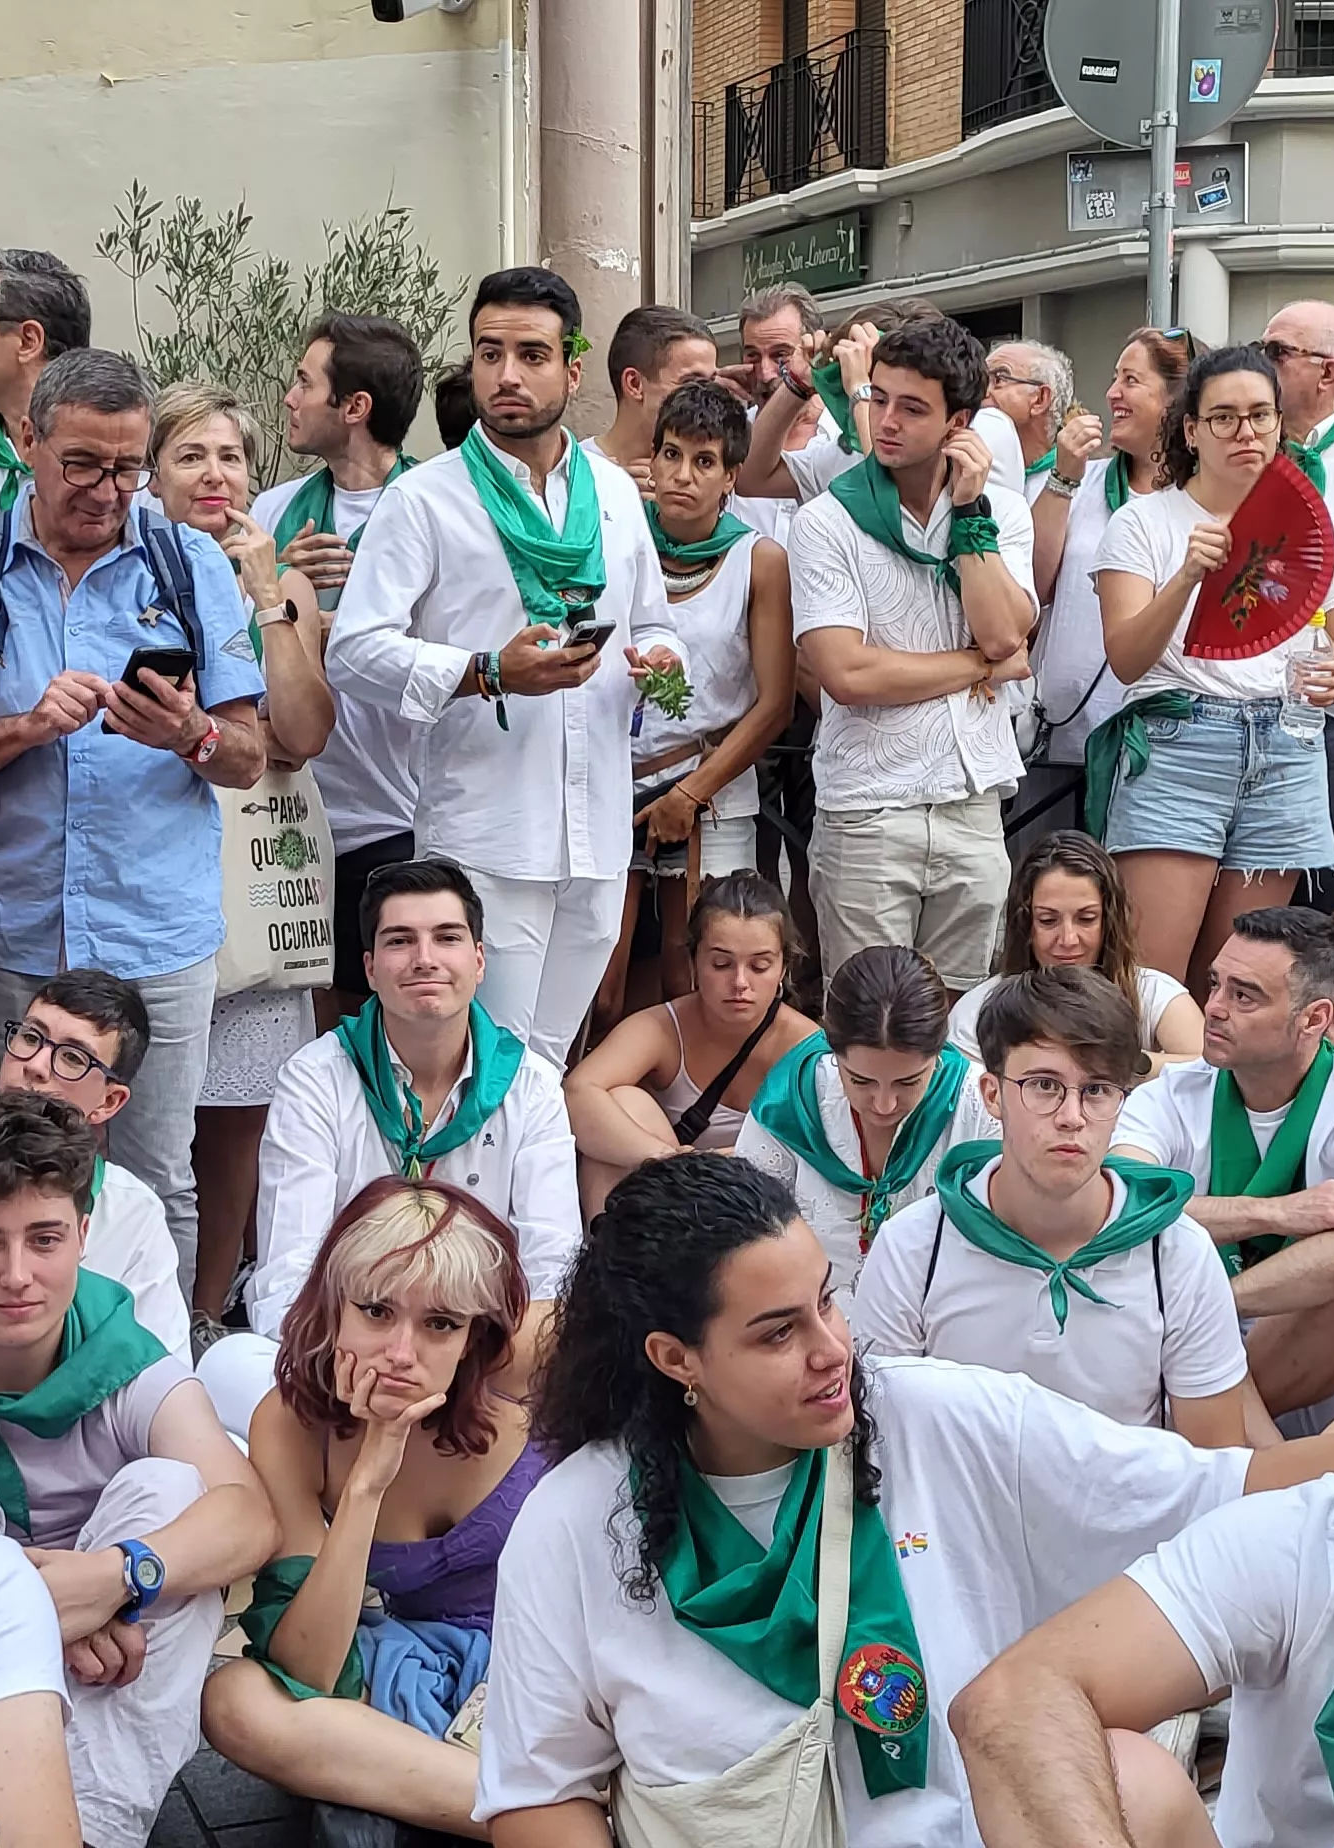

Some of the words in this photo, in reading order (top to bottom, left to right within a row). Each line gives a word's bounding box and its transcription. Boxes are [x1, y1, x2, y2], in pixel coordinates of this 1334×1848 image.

[786, 241, 804, 273] San
[805, 235, 840, 268] Lorenzo
[277, 877, 321, 908] COSAS
[267, 917, 333, 952] OCURRAN
